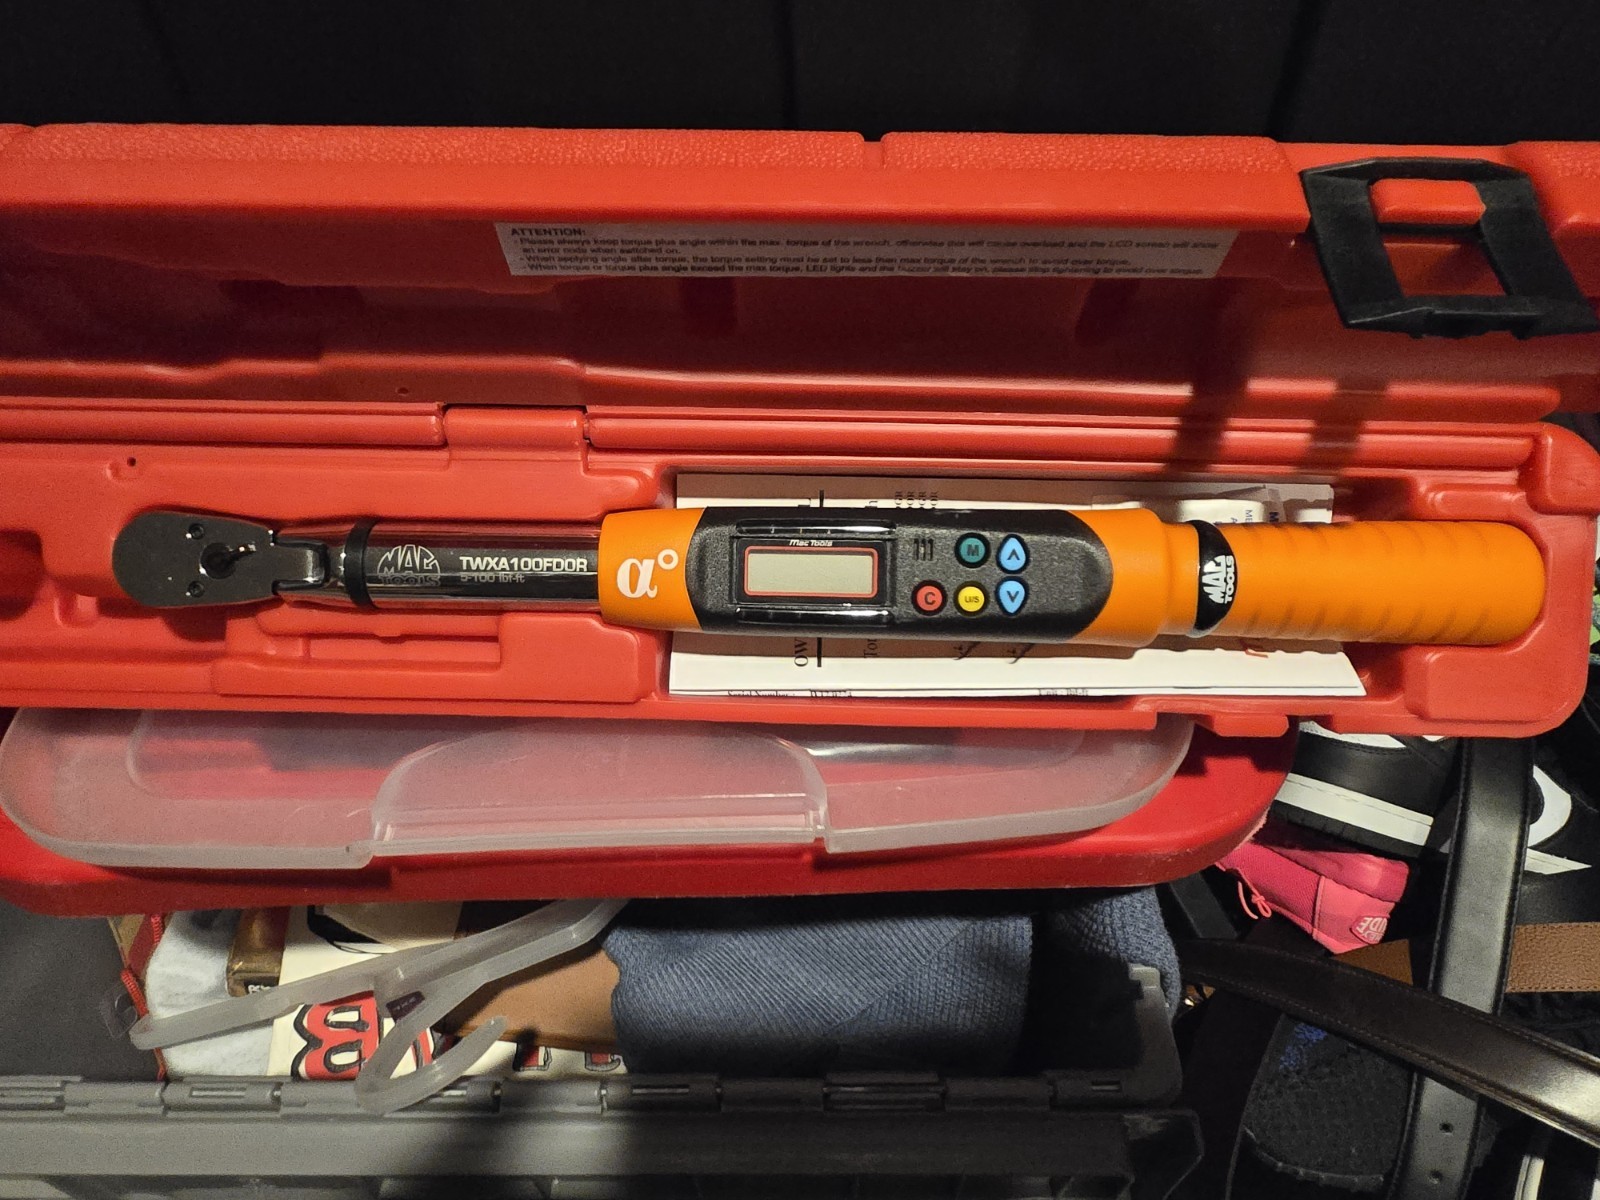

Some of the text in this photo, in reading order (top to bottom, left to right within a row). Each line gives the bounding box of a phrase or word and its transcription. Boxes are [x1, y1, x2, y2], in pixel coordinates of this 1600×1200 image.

[511, 228, 585, 236] ATTENTION:
[557, 238, 591, 247] always
[593, 238, 619, 247] keep
[621, 239, 652, 247] torque
[655, 238, 676, 247] plus
[679, 239, 706, 247] angle
[786, 239, 819, 248] torque
[821, 239, 832, 247] of
[834, 239, 850, 247] the
[895, 240, 945, 248] otherwise
[1020, 240, 1065, 248] overload
[1108, 240, 1133, 248] LCD
[1172, 241, 1190, 249] will
[557, 256, 598, 264] applying
[601, 256, 627, 264] angle
[711, 256, 742, 265] torque
[745, 257, 777, 265] setting
[923, 258, 956, 266] torque
[528, 263, 558, 271] When
[559, 264, 590, 272] torque
[605, 264, 636, 272] torque
[639, 264, 659, 272] plus
[661, 264, 688, 273] angle
[830, 264, 856, 273] lights
[952, 265, 973, 273] stay
[1052, 267, 1102, 275] tightening
[966, 544, 979, 556] M
[377, 544, 441, 575] MAC
[1202, 555, 1226, 604] MAC
[1224, 555, 1235, 604] TOOLS
[924, 591, 936, 605] C
